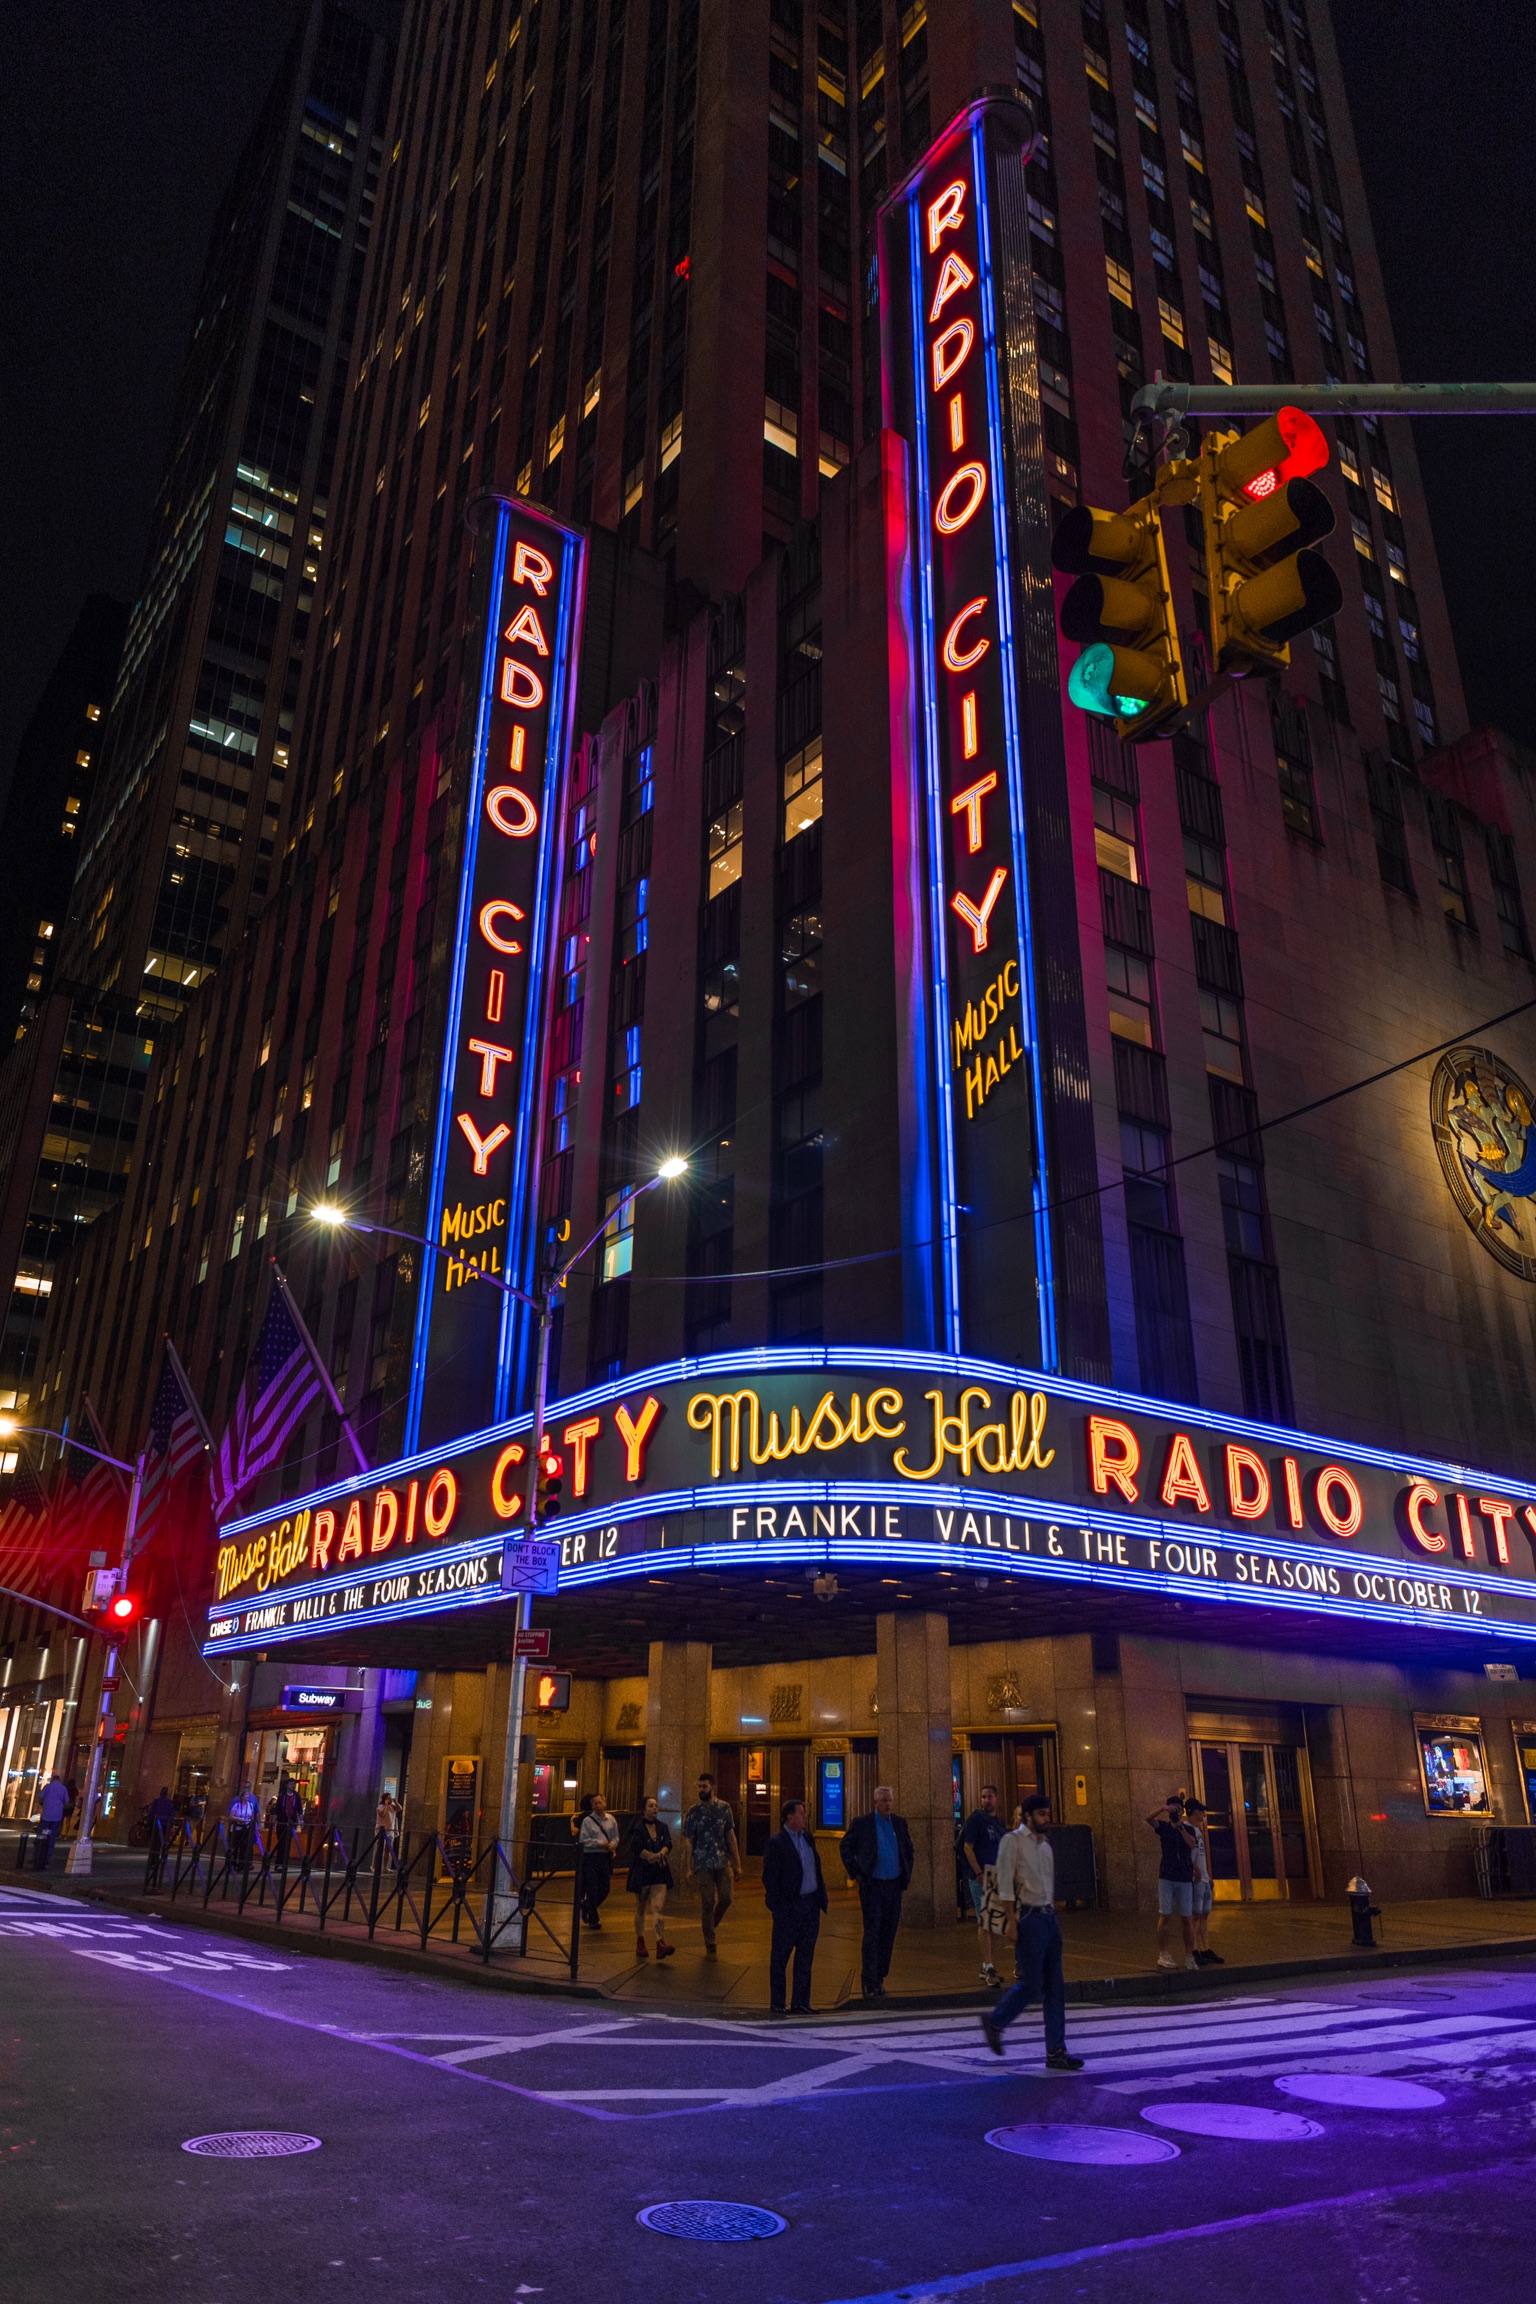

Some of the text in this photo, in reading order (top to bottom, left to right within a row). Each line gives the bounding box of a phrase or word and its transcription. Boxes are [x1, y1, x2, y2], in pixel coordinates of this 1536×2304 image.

[927, 179, 1008, 954] RADIO CITY
[456, 541, 553, 1175] RADIO CITY
[954, 959, 1019, 1068] MUSIC
[965, 1024, 1023, 1120] HALL
[441, 1198, 507, 1247] MUSIC
[445, 1246, 501, 1292] HALL
[686, 1386, 1056, 1480] Music Hall
[310, 1395, 662, 1570] RADIO CTY
[1087, 1414, 1536, 1565] RADIO CIT
[217, 1508, 312, 1600] Music Hall
[244, 1603, 286, 1633] FRANKIE
[292, 1593, 326, 1621] VALLI
[343, 1584, 365, 1610] THE
[373, 1575, 409, 1604] FOUR
[416, 1556, 488, 1597] SEASONS
[598, 1526, 619, 1558] 12
[507, 1542, 556, 1556] DON'T BLOCK
[515, 1554, 547, 1567] THE BOX
[731, 1504, 1484, 1616] FRANKIE VALLI & THE FOUR SEASONS OCTOBER 12
[209, 1619, 233, 1638] CHASE
[299, 1692, 336, 1706] Subway
[70, 1950, 293, 1972] BUS
